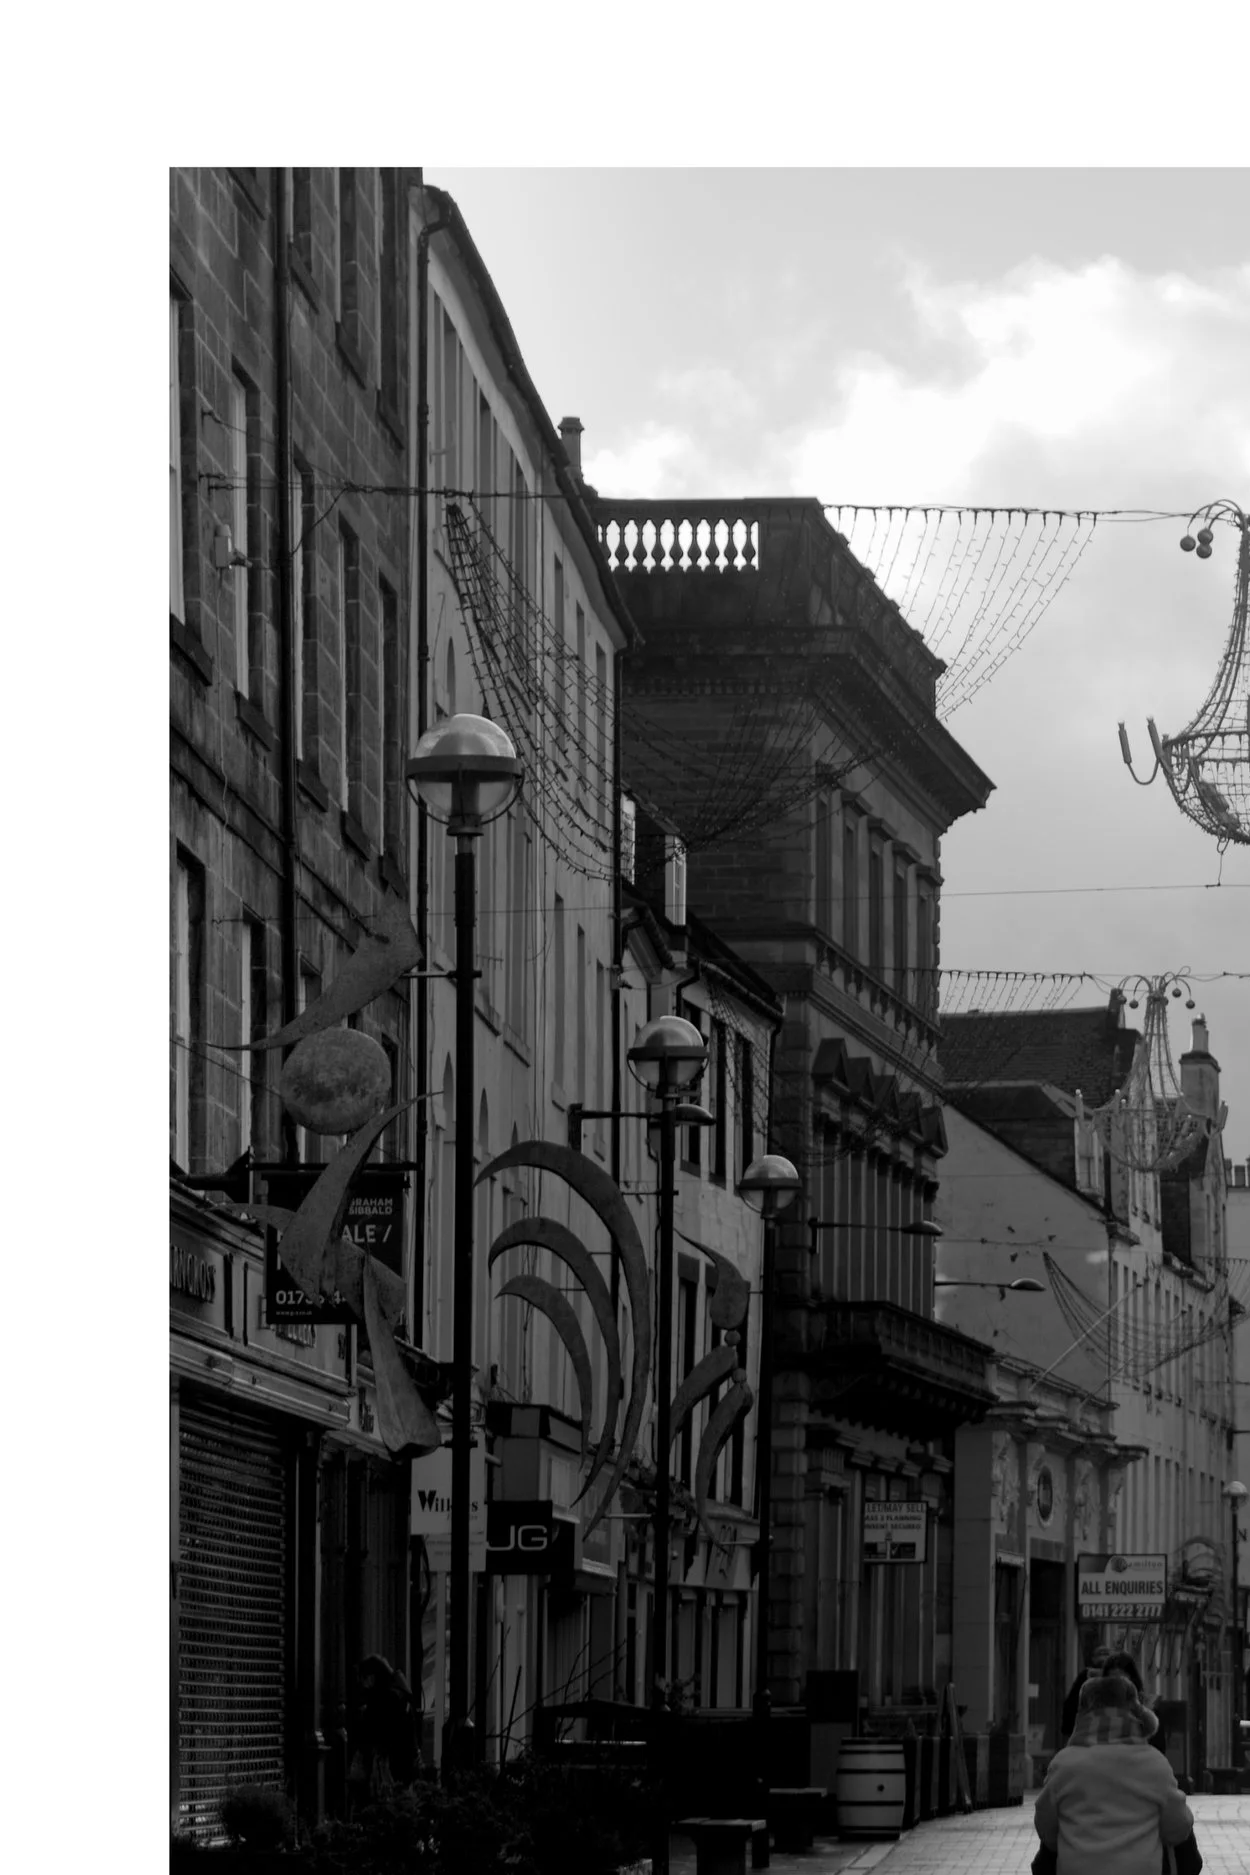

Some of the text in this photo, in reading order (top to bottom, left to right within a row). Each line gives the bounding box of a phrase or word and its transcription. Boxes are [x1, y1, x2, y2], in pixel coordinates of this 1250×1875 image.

[348, 1206, 393, 1215] SIBBALD
[340, 1224, 377, 1243] ALE
[1081, 1580, 1163, 1597] ALL ENQUIRIES
[1082, 1603, 1163, 1618] 0141 222 2777
